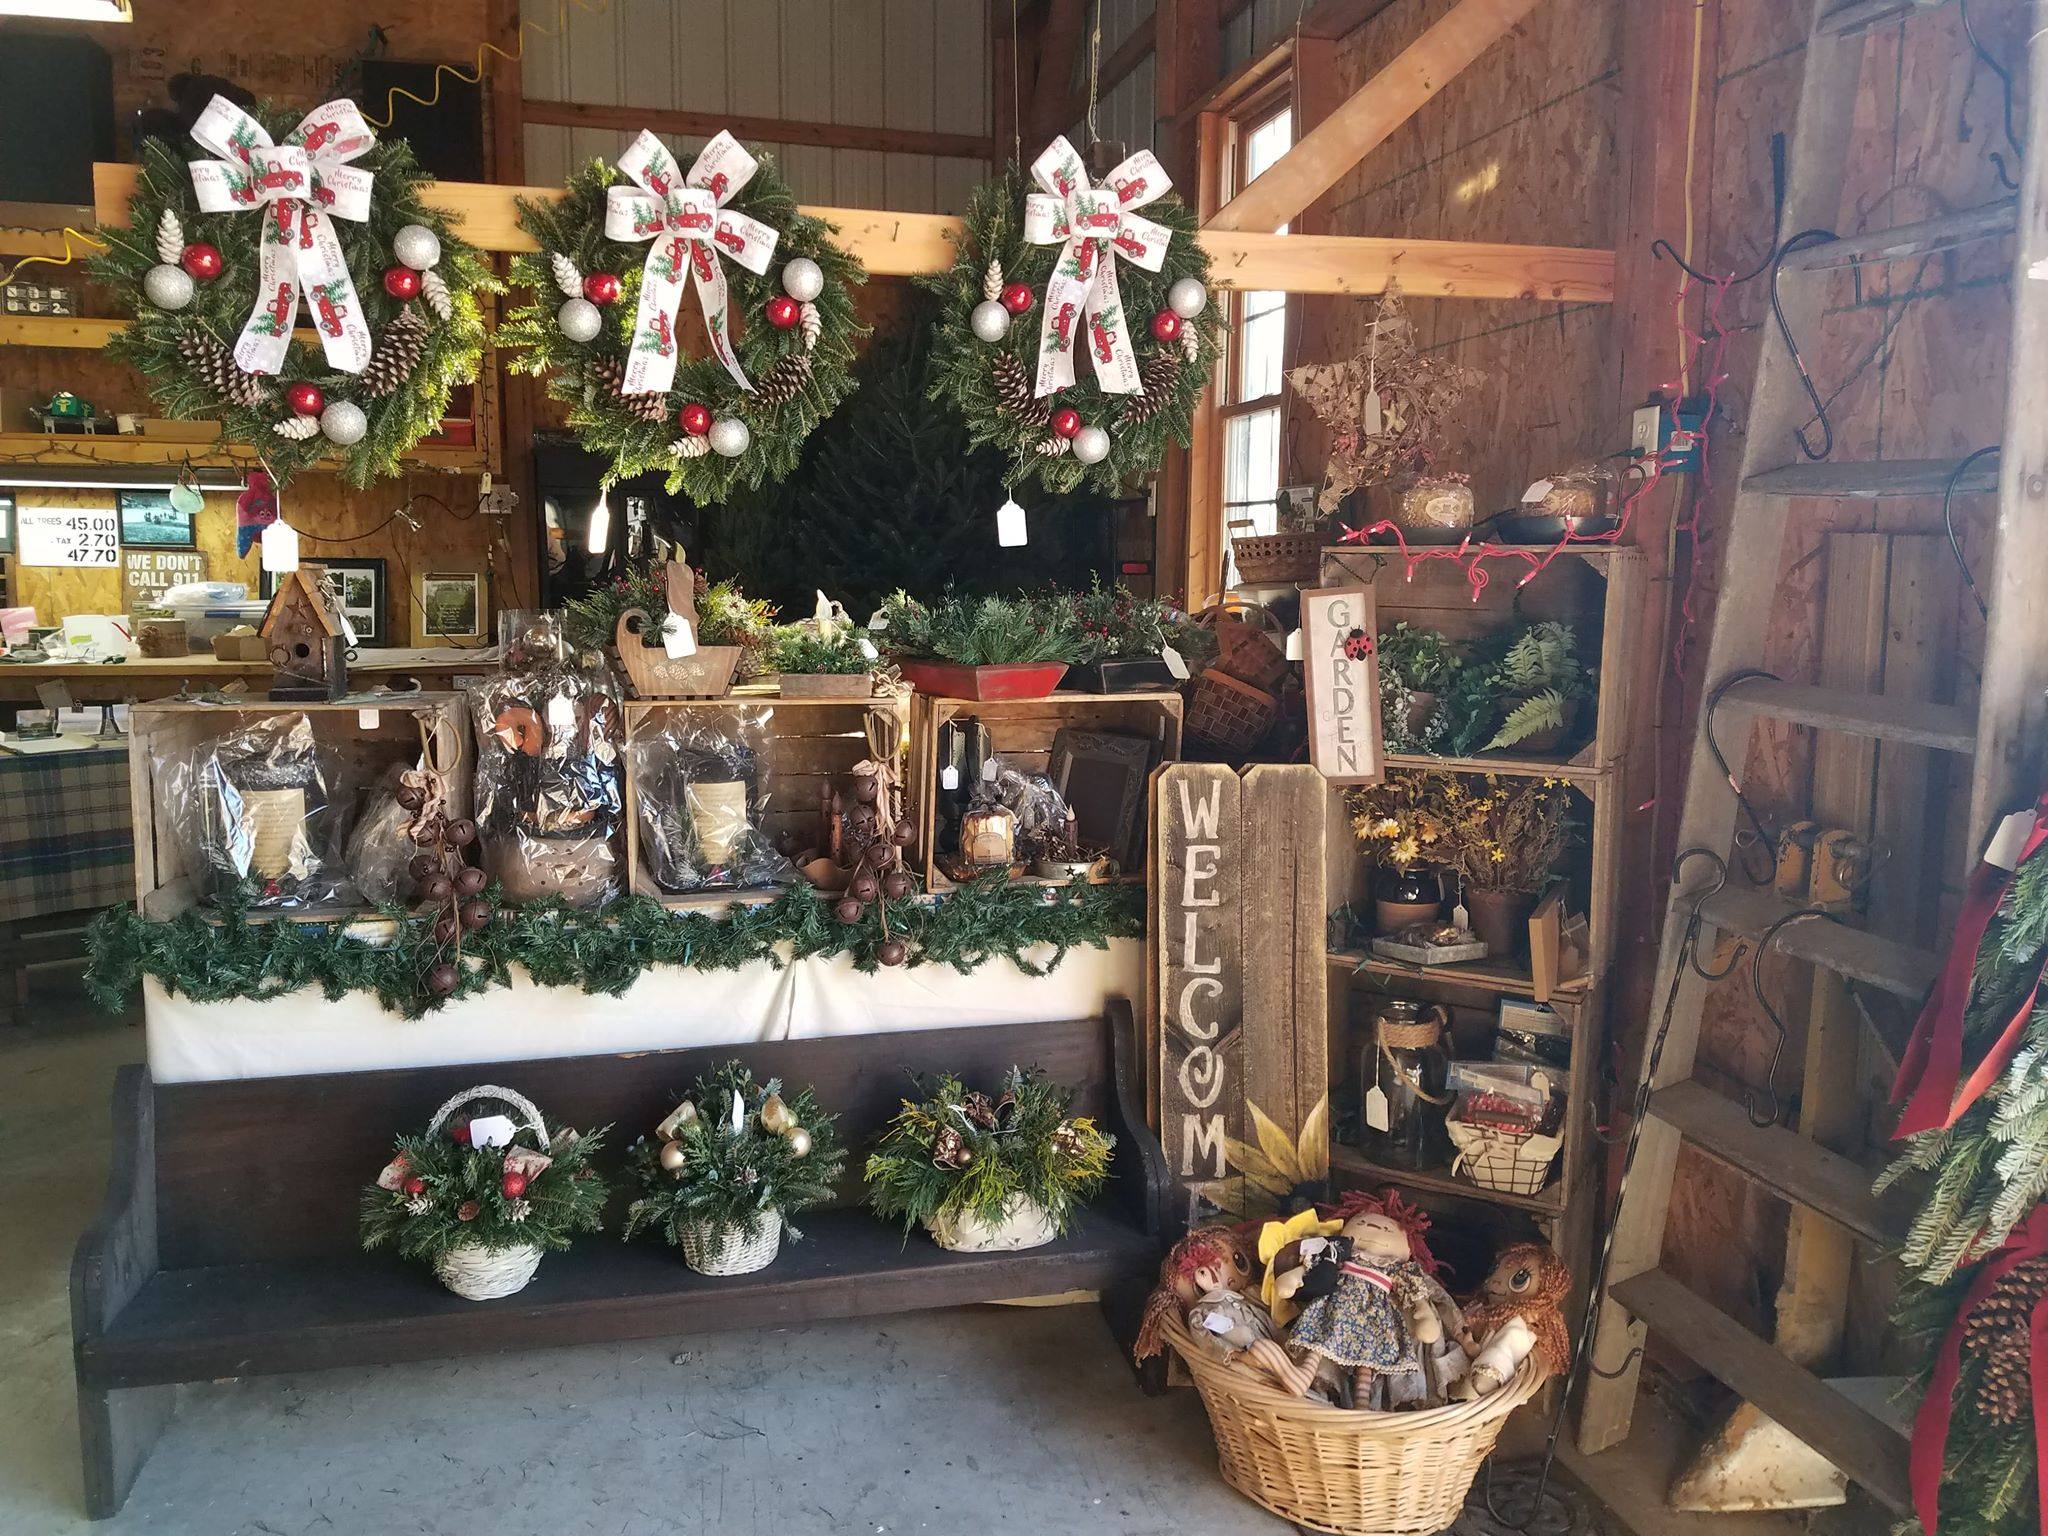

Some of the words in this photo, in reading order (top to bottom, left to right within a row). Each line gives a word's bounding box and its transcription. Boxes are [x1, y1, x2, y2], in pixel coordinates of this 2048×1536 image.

[325, 99, 354, 114] Merry
[703, 140, 723, 163] Merry
[704, 142, 734, 174] Christmas
[191, 166, 210, 178] erry
[334, 167, 363, 184] Merry
[1129, 157, 1157, 176] Christma
[327, 174, 370, 194] Christmas
[740, 224, 774, 250] Christmas
[747, 221, 770, 240] Merry
[317, 233, 335, 278] Christmas
[328, 240, 340, 269] Merry
[262, 255, 271, 284] Merry
[268, 248, 277, 292] Christmas
[1105, 269, 1114, 295] Merry
[1048, 281, 1060, 304] Merry
[1052, 279, 1066, 310] Christmas
[1100, 264, 1110, 304] Christmas
[235, 340, 250, 362] Merry
[346, 323, 362, 367] Christmas
[356, 330, 367, 358] Merry
[627, 359, 640, 387] Merry
[1038, 363, 1050, 387] Merry
[1115, 348, 1129, 387] Christmas
[1123, 353, 1134, 379] Merry
[37, 517, 62, 526] TREES
[66, 517, 115, 531] 45.00
[78, 533, 116, 547] 2.70
[67, 549, 116, 563] 47.70
[126, 554, 151, 570] WE
[156, 554, 202, 571] DON'T
[128, 572, 168, 587] CALL
[173, 572, 200, 587] 911
[1326, 599, 1358, 774] GARDEN
